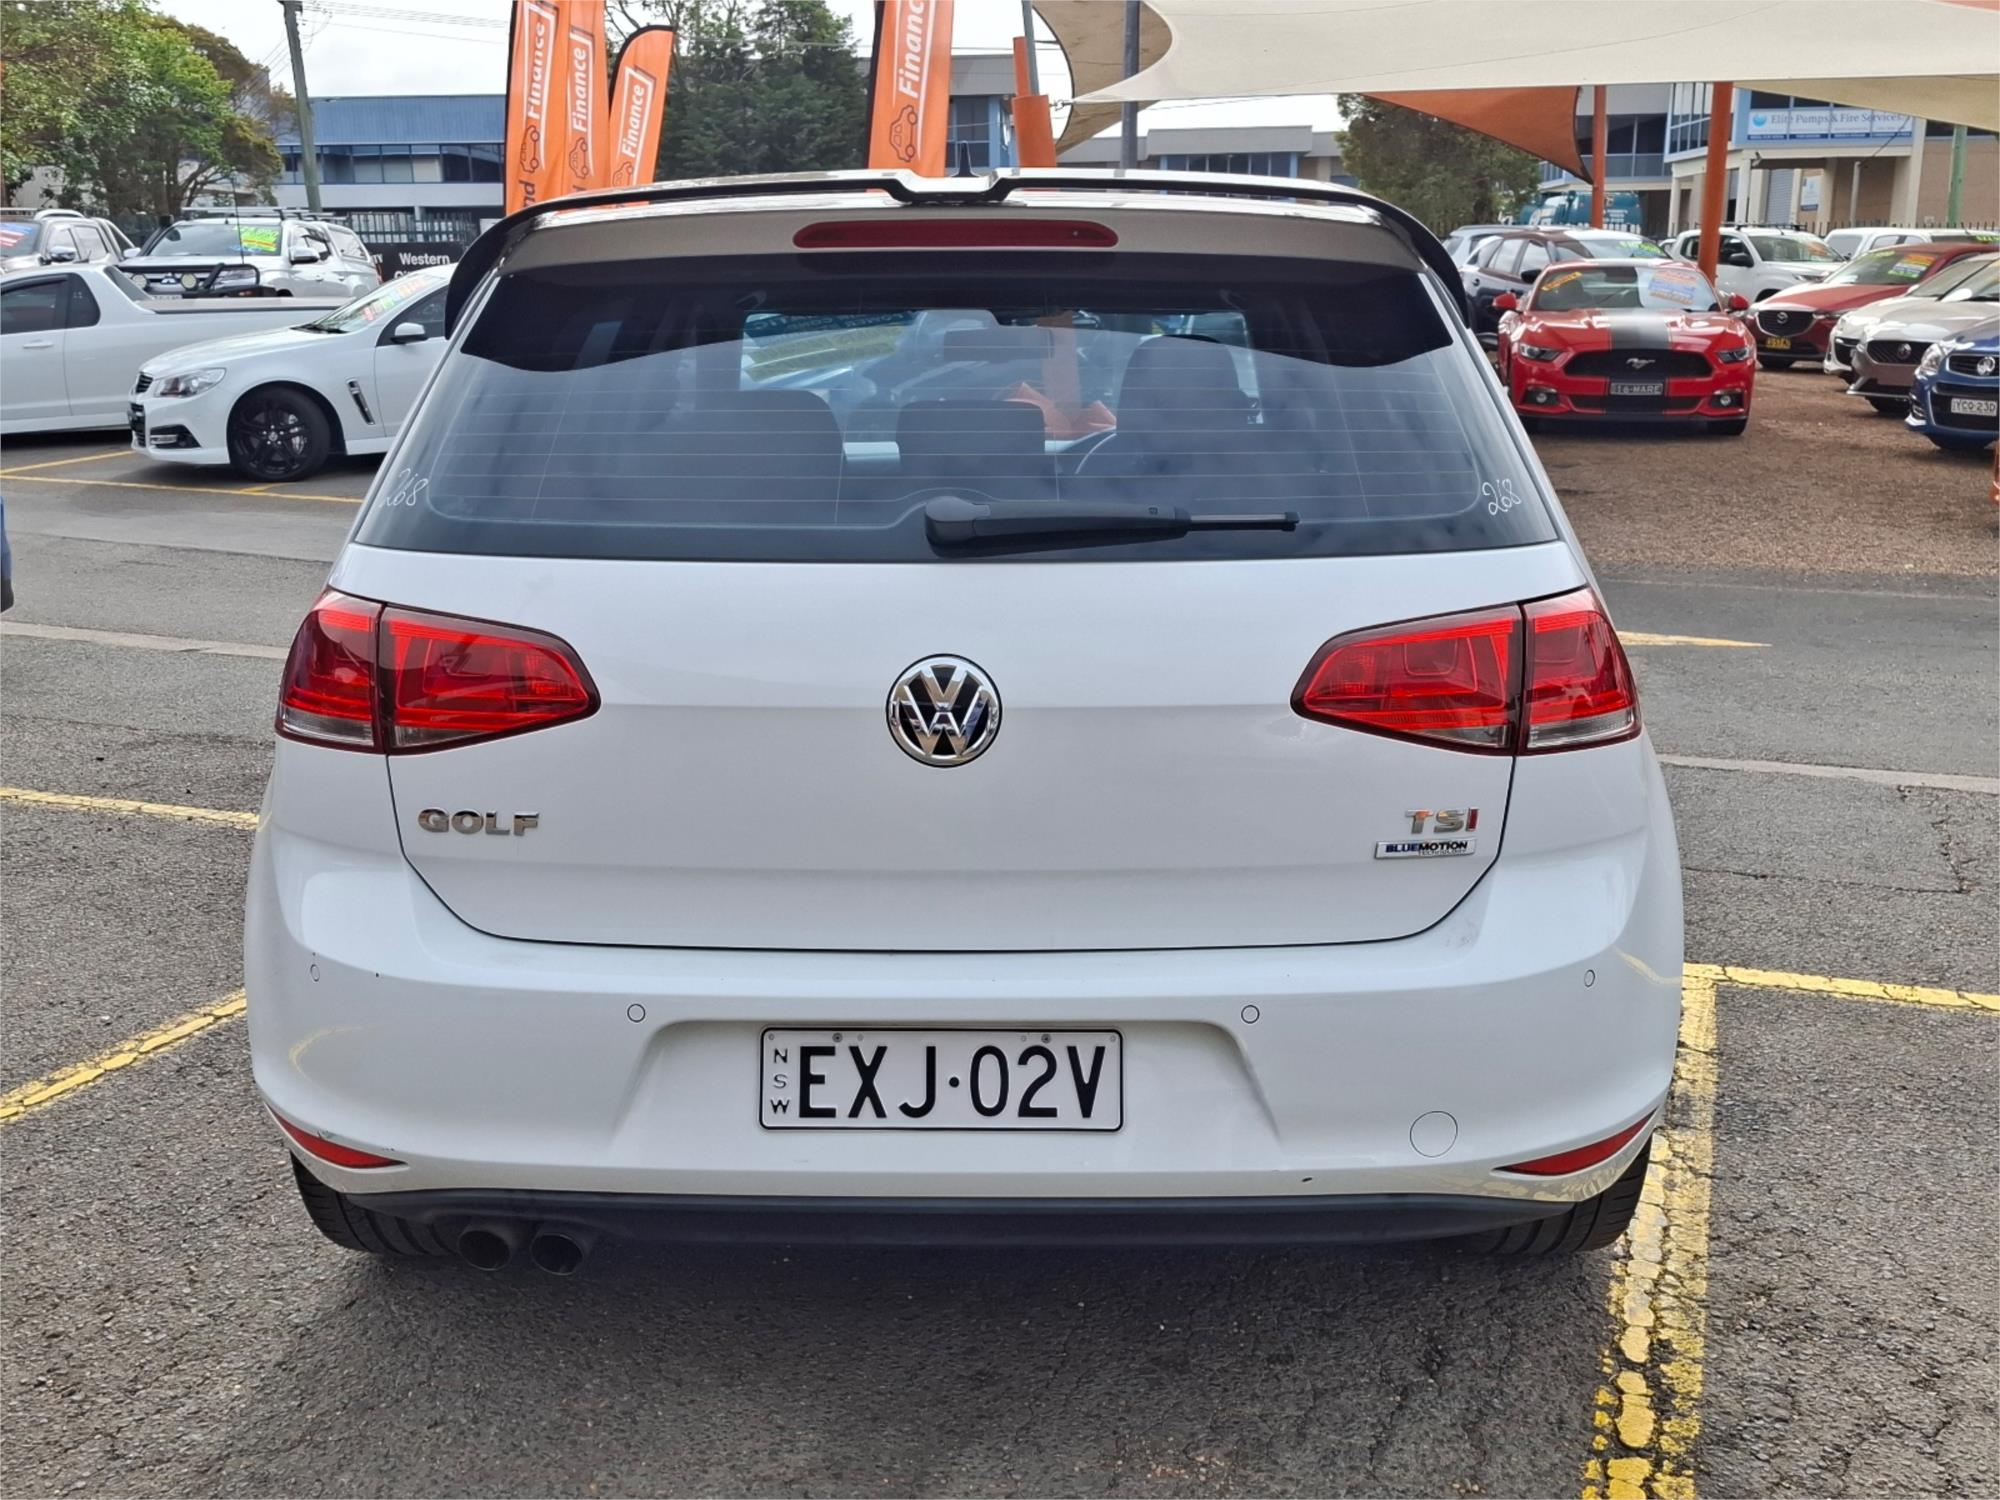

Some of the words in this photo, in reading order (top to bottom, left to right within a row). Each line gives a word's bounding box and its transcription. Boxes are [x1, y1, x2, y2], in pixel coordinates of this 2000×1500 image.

[898, 0, 924, 98] Financ
[527, 22, 545, 120] Finance
[572, 46, 588, 132] Finance
[620, 83, 645, 158] Finance
[1770, 115, 1793, 124] Elite
[1796, 114, 1828, 125] Pumps
[1840, 113, 1859, 122] Fire
[398, 252, 450, 265] Western
[417, 806, 540, 836] GOLF
[1405, 806, 1479, 834] TSI
[1385, 841, 1468, 853] BLUEMOTION
